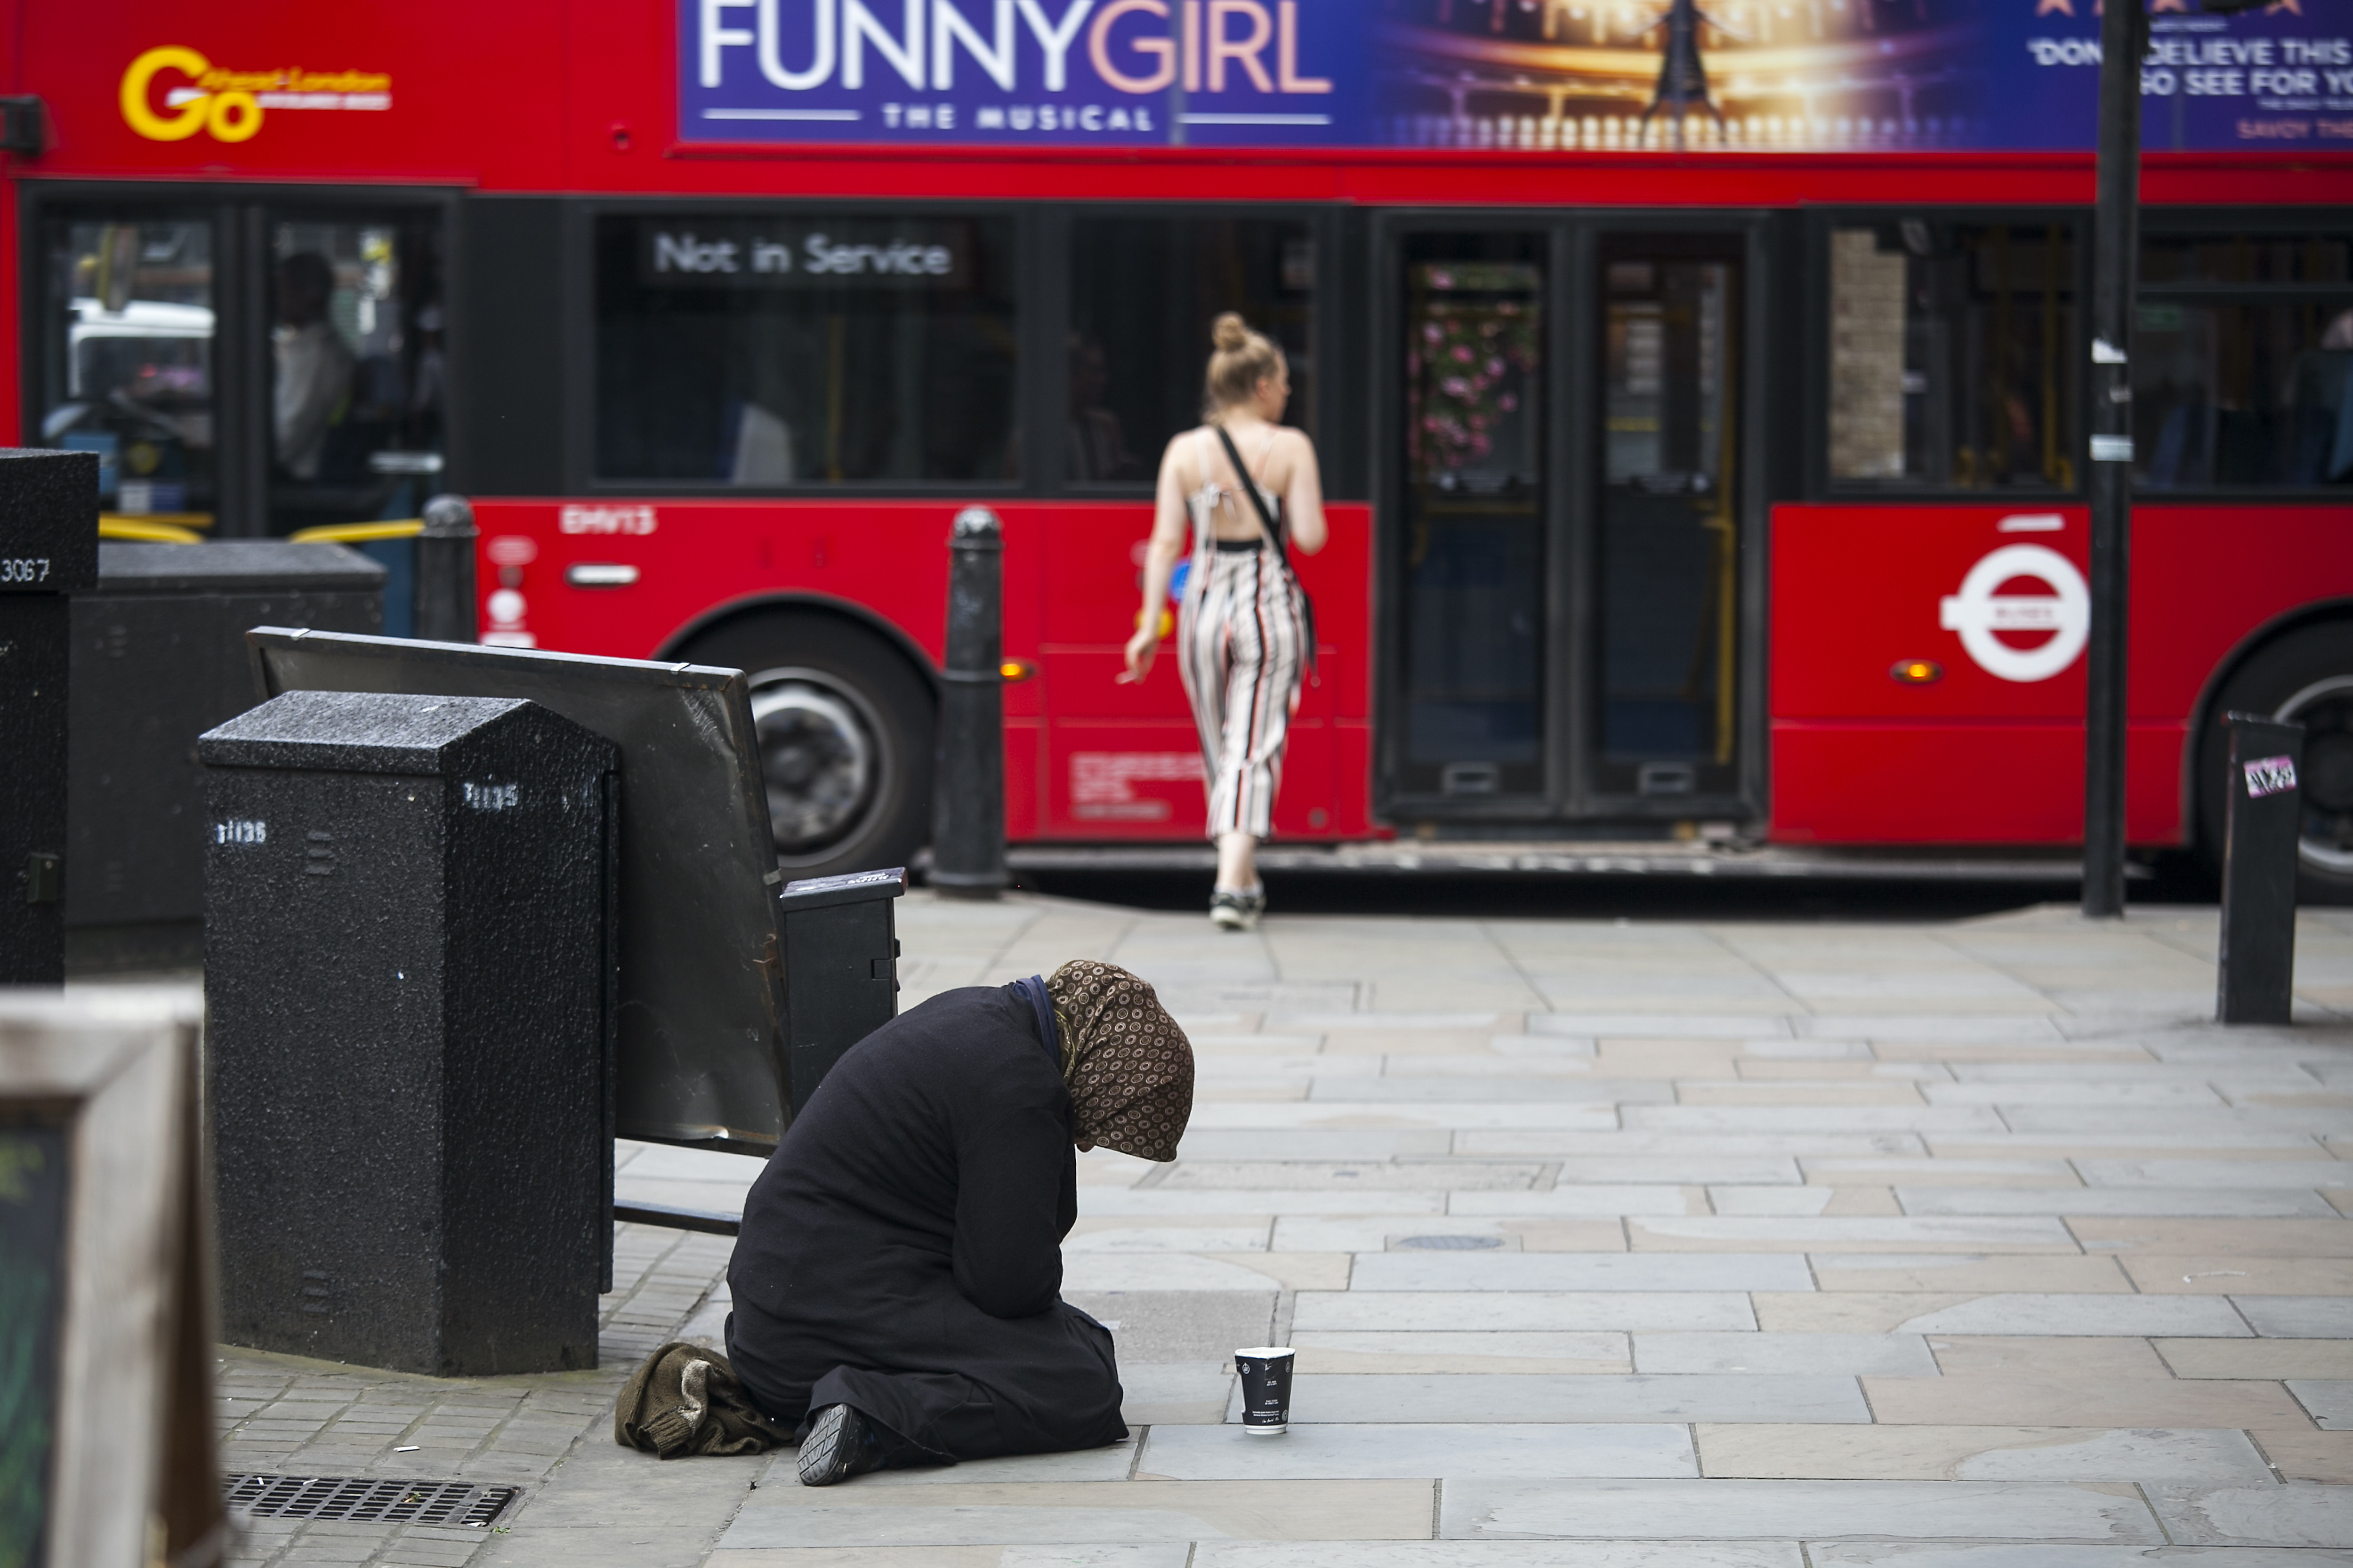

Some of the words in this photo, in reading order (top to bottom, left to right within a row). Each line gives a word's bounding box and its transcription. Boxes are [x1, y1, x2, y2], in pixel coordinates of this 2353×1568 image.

[2281, 38, 2351, 65] THIS
[2184, 68, 2246, 96] SEE
[2248, 68, 2319, 96] FOR
[881, 101, 958, 130] THE
[975, 104, 1155, 132] MUSICAL
[655, 233, 740, 274] Not
[751, 237, 793, 273] in
[803, 234, 954, 275] Service
